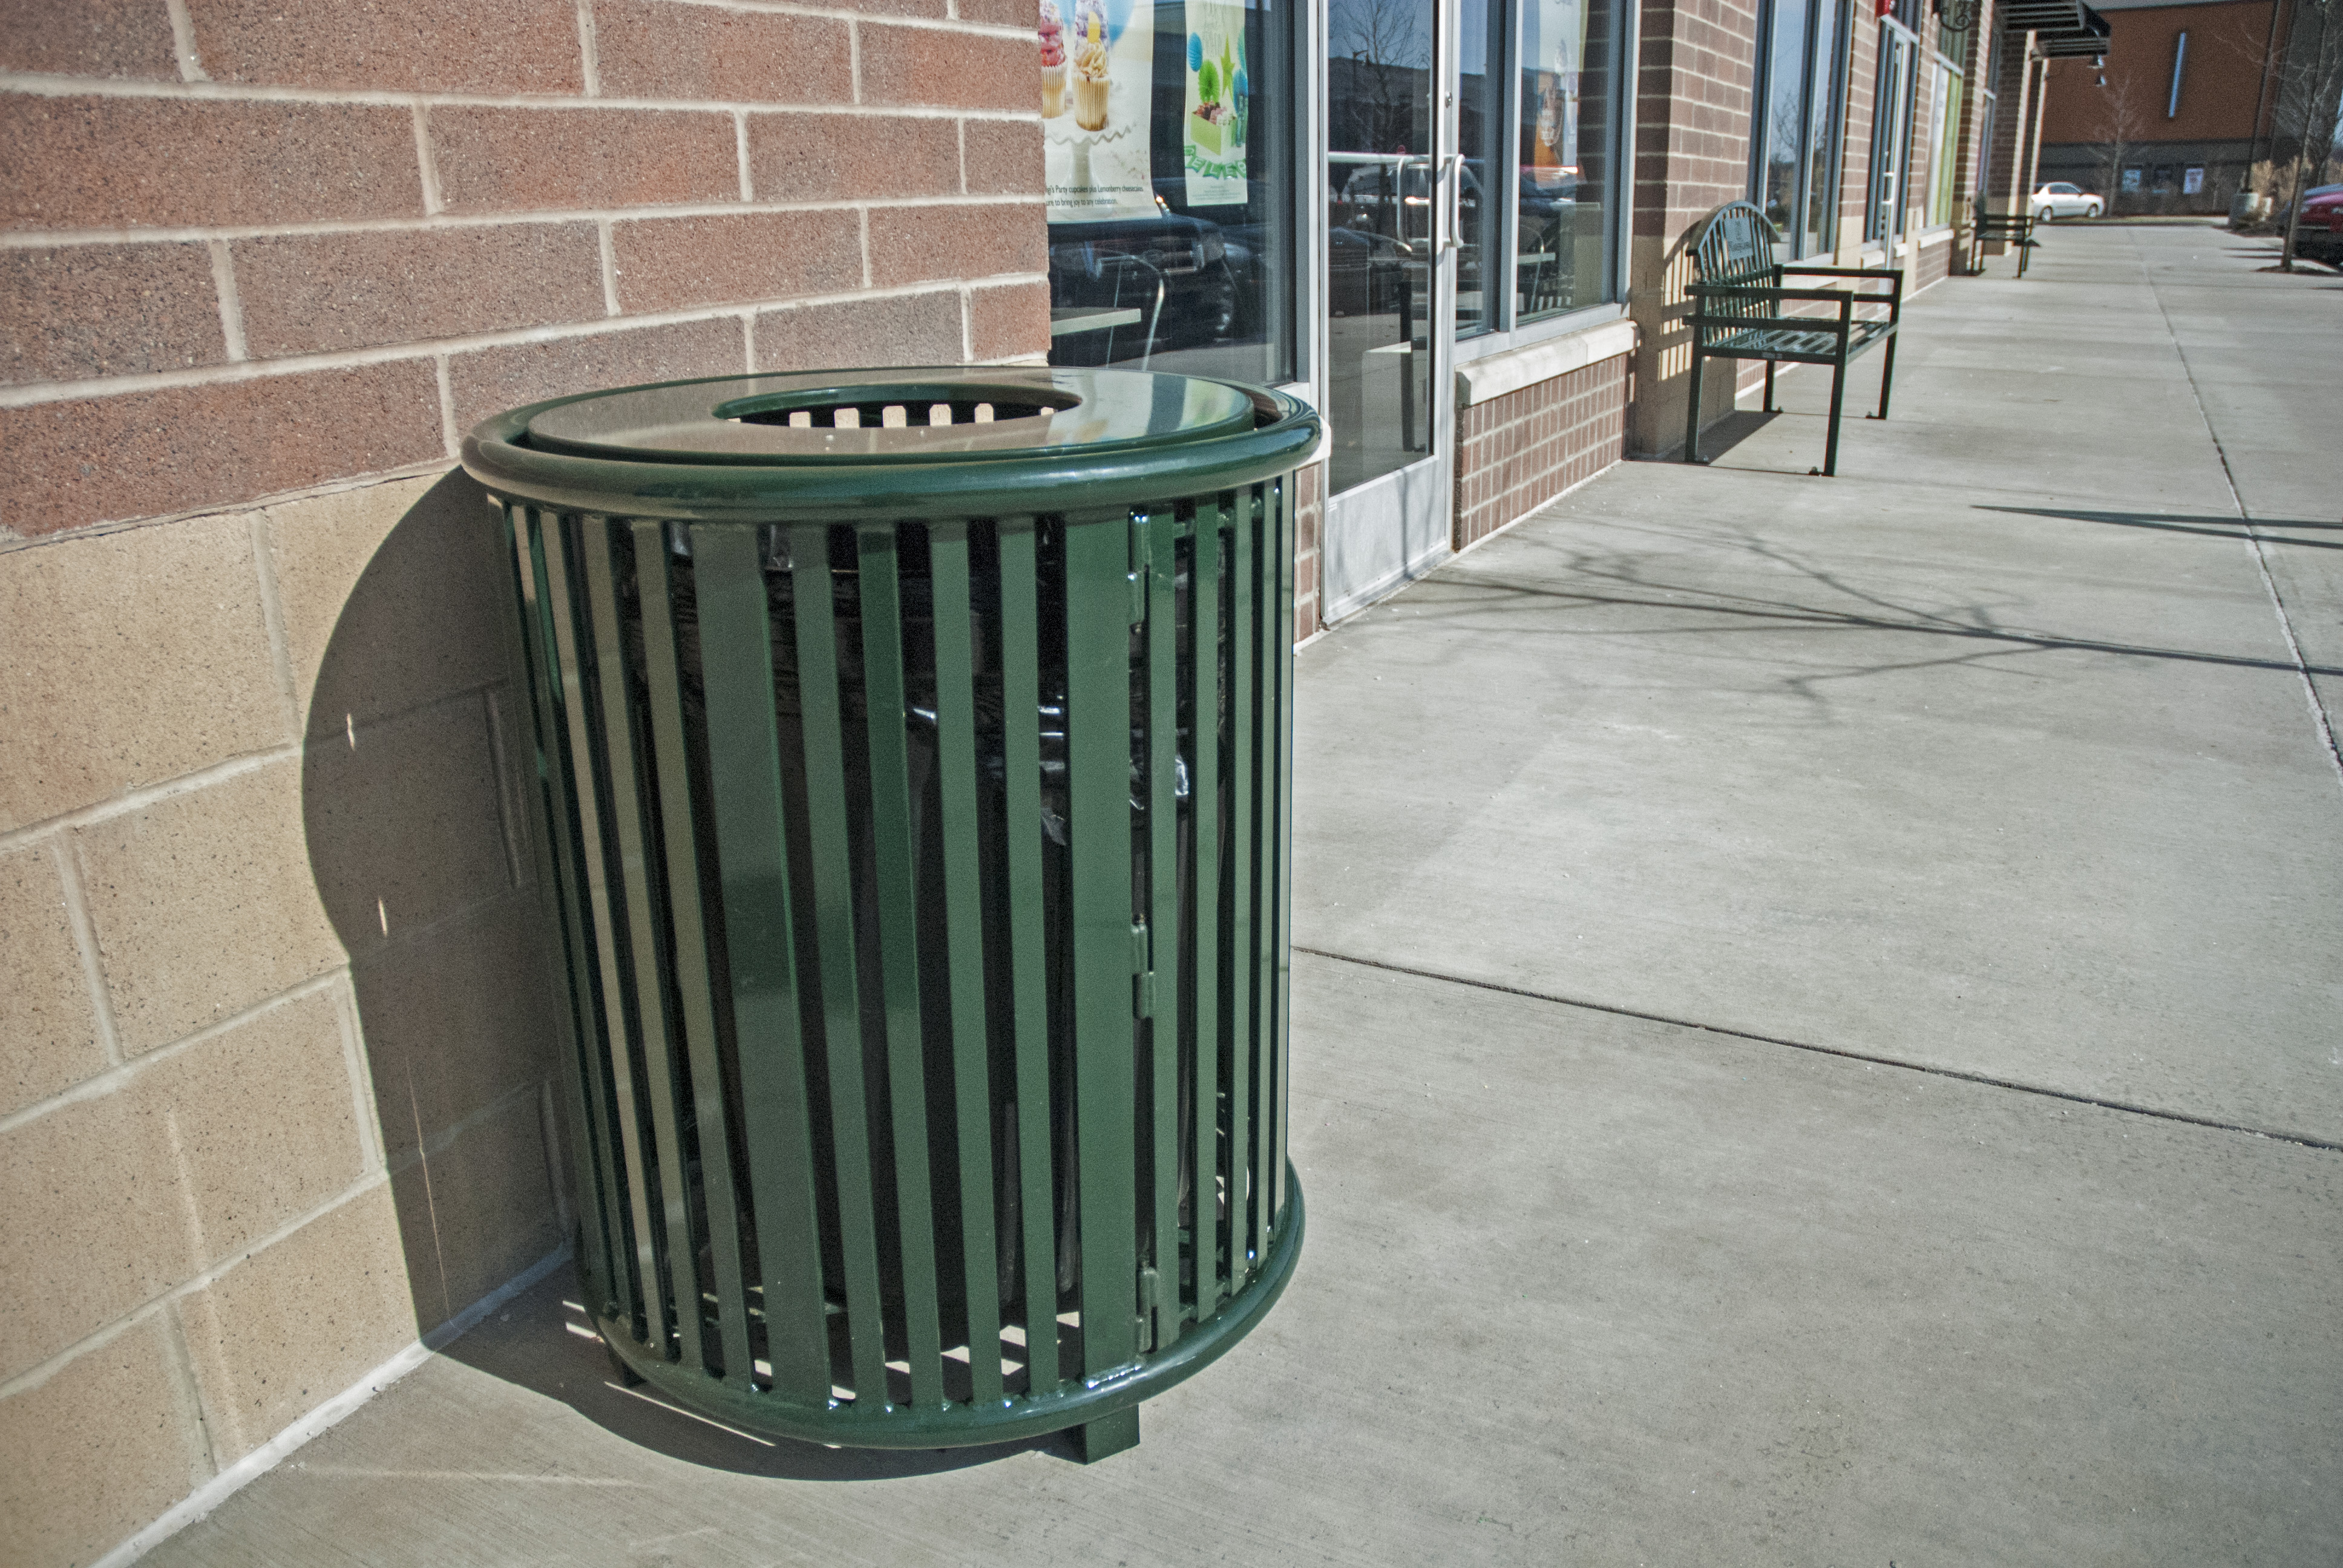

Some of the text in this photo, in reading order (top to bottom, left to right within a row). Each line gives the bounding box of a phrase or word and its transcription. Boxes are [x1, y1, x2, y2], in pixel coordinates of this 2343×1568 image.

[1055, 185, 1067, 195] Party
[1069, 185, 1088, 195] cupcakes
[1061, 198, 1073, 207] bring
